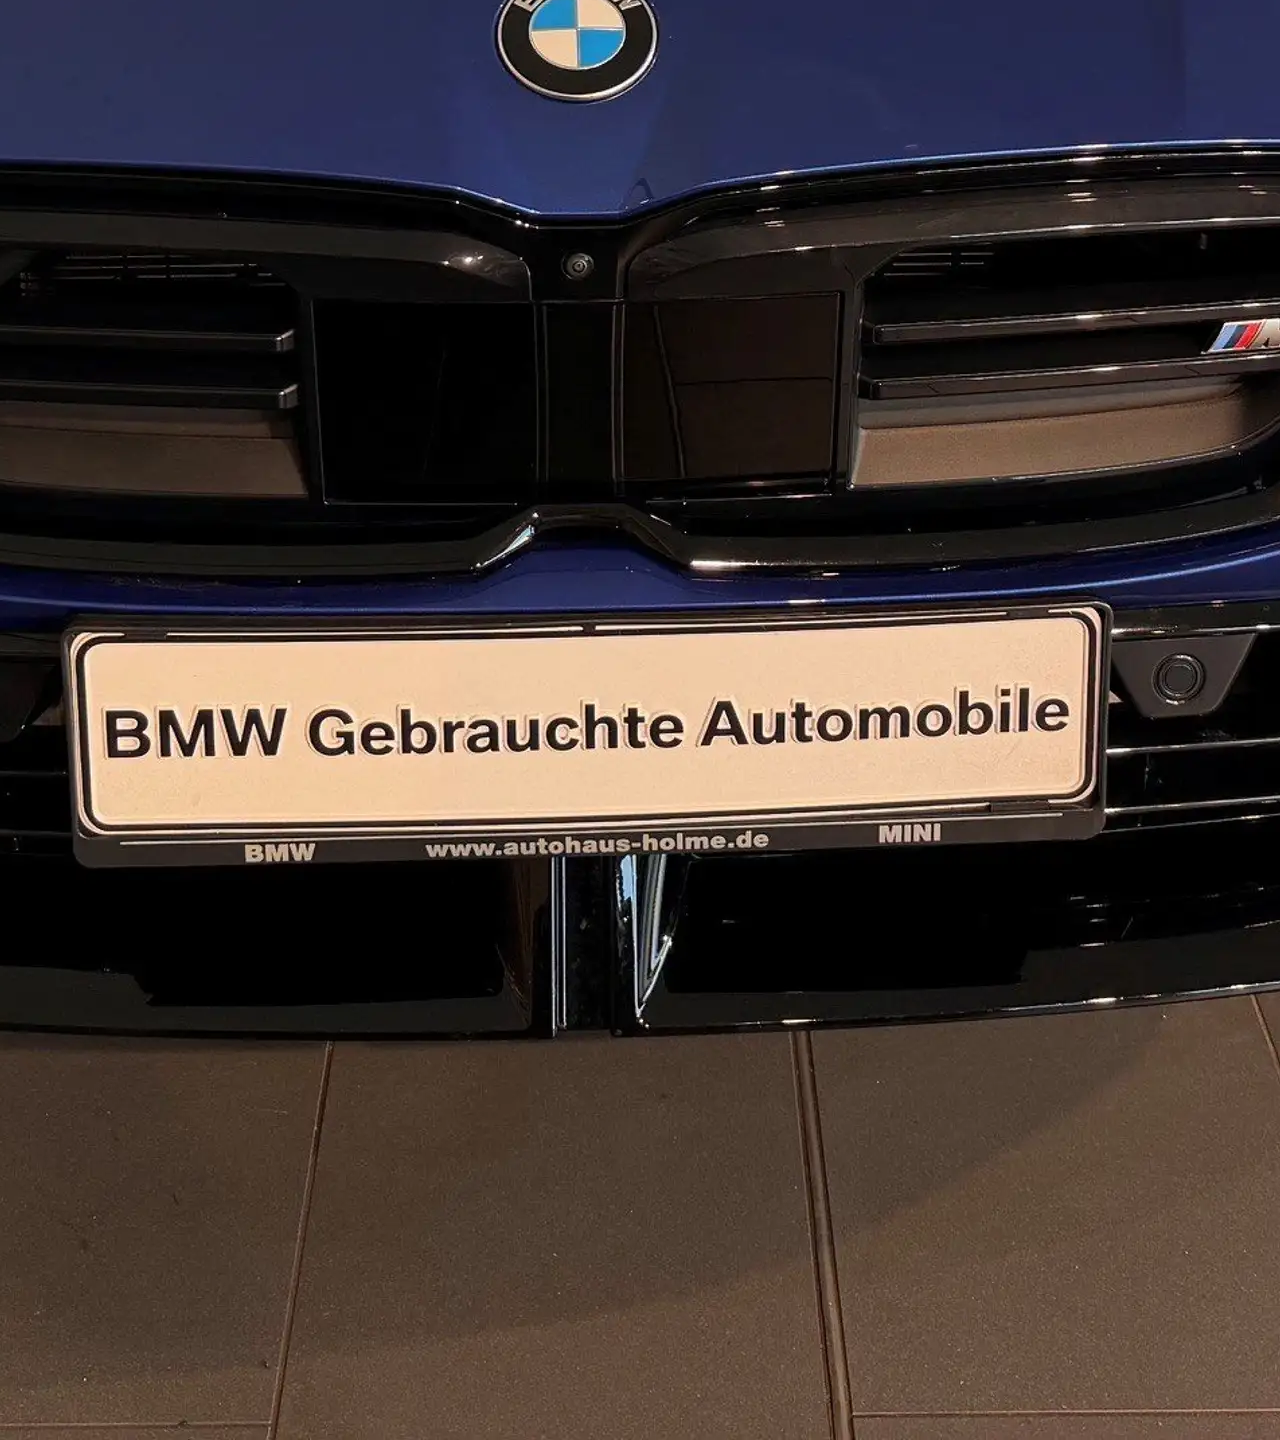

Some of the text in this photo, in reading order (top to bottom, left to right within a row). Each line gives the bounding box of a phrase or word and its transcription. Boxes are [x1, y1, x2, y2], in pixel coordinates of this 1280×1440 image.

[104, 687, 1070, 759] BMW Gebrauchte Automobile
[244, 823, 942, 863] BMW www.autohaus-holme.de MINI
